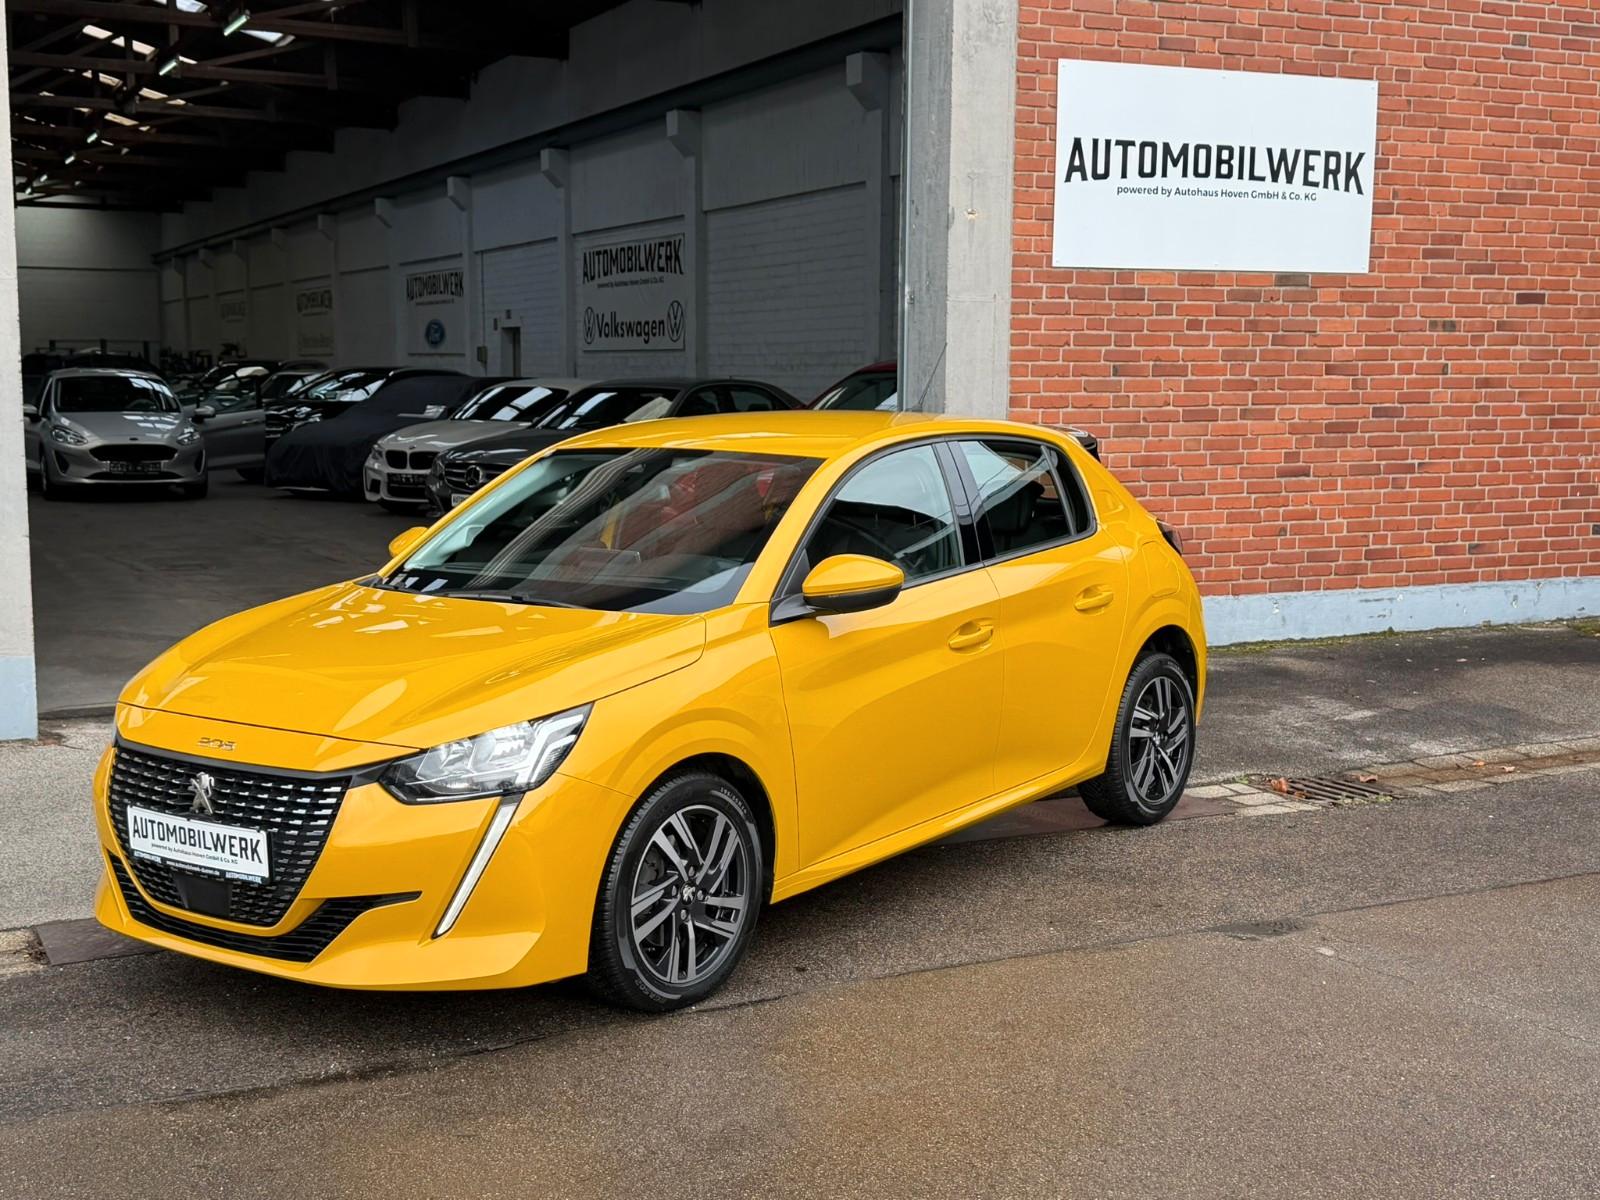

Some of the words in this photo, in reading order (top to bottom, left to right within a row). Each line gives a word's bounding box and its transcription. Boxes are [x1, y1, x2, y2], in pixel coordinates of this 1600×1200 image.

[1064, 137, 1366, 195] AUTOMOBILWERK
[1116, 185, 1158, 197] powered
[1161, 185, 1173, 198] by
[1174, 187, 1218, 198] Autohaus
[1221, 188, 1249, 199] Hoven
[1251, 189, 1279, 200] GmbH
[1281, 191, 1287, 201] &
[1289, 192, 1302, 201] Co.
[1304, 192, 1317, 201] KG
[583, 239, 684, 284] AUTOMOBILWERK
[596, 311, 665, 344] Volkswagen
[133, 815, 263, 864] AUTOMOBILWERK
